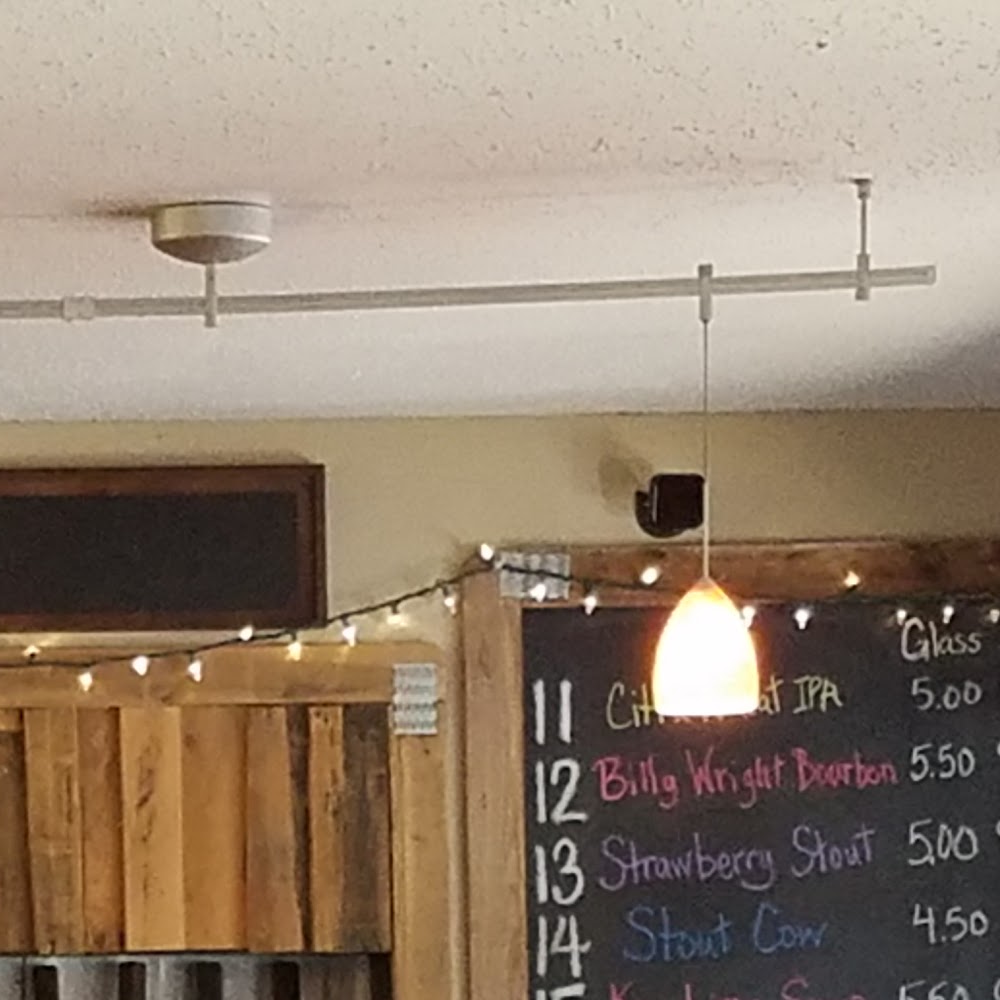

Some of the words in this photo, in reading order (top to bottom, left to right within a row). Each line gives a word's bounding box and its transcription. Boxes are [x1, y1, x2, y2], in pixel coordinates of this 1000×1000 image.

[901, 617, 983, 662] Glass
[532, 678, 573, 745] 11
[793, 674, 844, 714] IPA
[911, 676, 983, 711] 5.00
[535, 758, 588, 825] 12
[591, 755, 680, 809] Billy
[910, 743, 976, 783] 5.50
[534, 837, 585, 906] 13
[598, 833, 774, 892] Strawberry
[790, 824, 877, 880] Stout
[907, 819, 979, 867] 5.00
[536, 914, 592, 978] 14
[622, 906, 732, 963] Stout
[752, 903, 829, 955] Cow
[912, 903, 989, 945] 4.50
